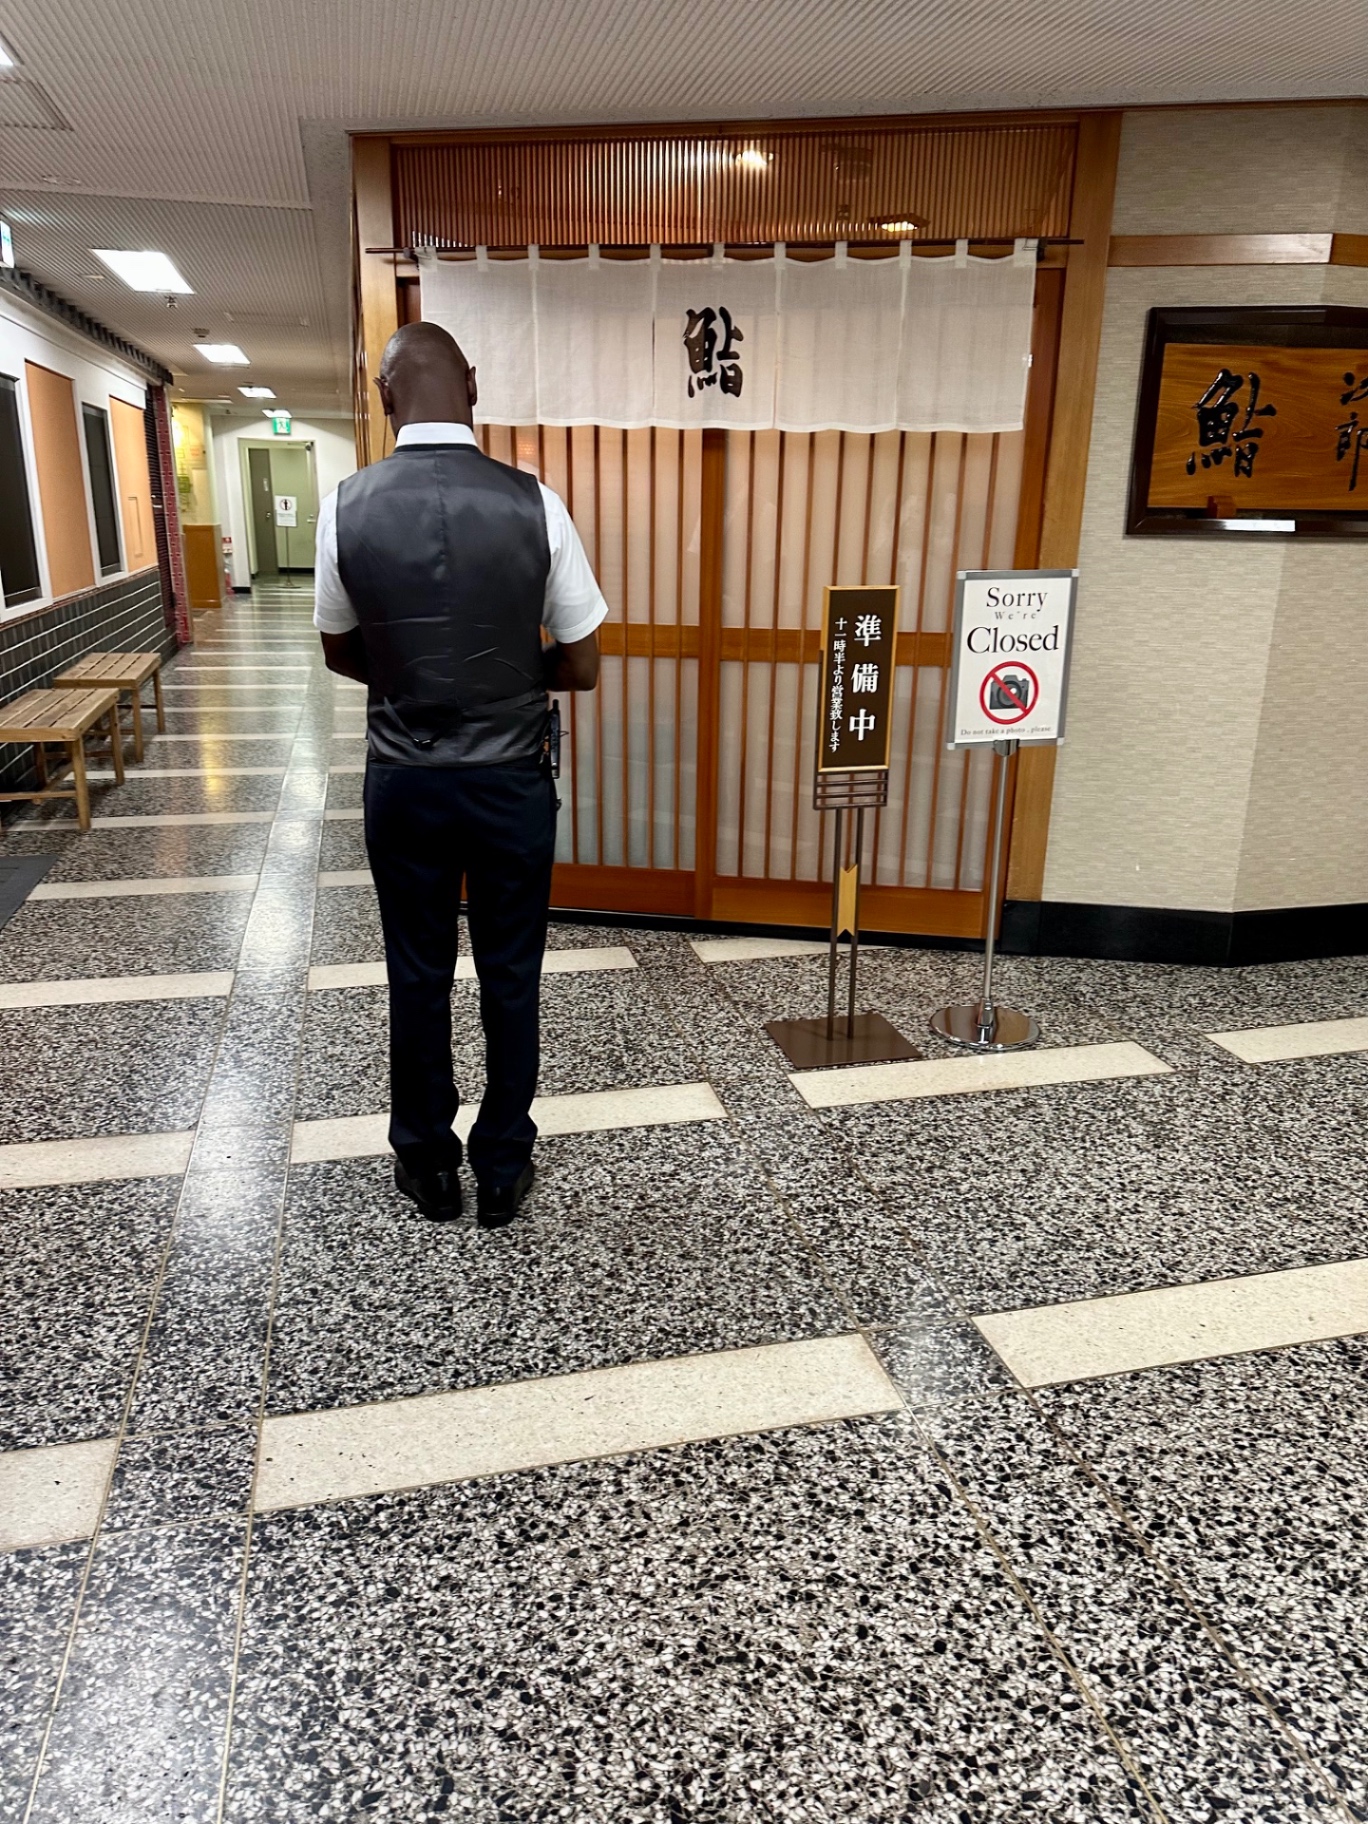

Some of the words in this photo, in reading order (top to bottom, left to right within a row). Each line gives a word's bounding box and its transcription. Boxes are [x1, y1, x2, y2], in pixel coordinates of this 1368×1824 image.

[682, 306, 744, 398] 鮨
[1186, 368, 1277, 478] 鮨
[966, 625, 1060, 655] Closed
[986, 587, 1048, 612] Sorry
[828, 617, 848, 753] 十一時半より営業致します
[848, 614, 882, 741] 準備中
[961, 729, 972, 737] Do
[1006, 727, 1025, 736] photo
[1030, 726, 1051, 735] please
